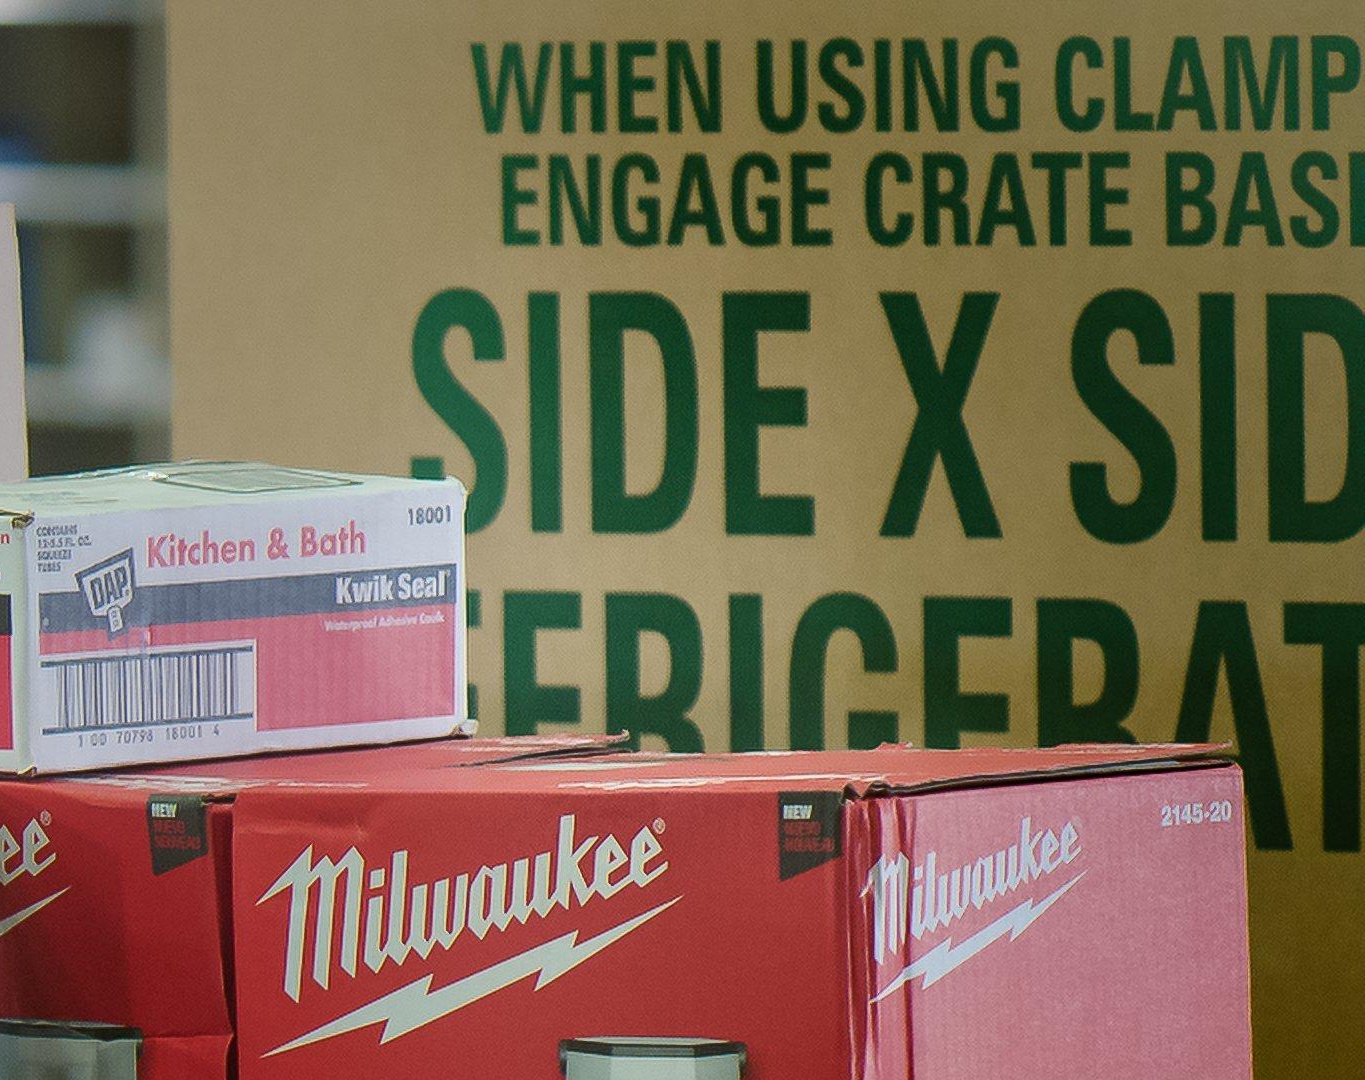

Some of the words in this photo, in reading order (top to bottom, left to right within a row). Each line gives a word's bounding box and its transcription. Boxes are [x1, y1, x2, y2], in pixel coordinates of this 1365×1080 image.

[470, 40, 722, 134] WHEN
[757, 39, 1020, 133] USING
[1054, 35, 1362, 132] CLAMP
[502, 152, 833, 247] ENGAGE
[867, 152, 1132, 247] CRATE
[410, 287, 815, 536] SIDE
[877, 291, 1002, 540] X
[146, 531, 256, 568] Kitchen
[267, 528, 290, 560] &
[300, 520, 367, 558] Bath
[407, 505, 452, 526] 18001
[88, 567, 128, 611] DAP
[335, 574, 395, 605] Kwik
[396, 570, 450, 601] Seal
[1160, 800, 1233, 827] 2145-20
[255, 813, 671, 1004] Milwaukee
[859, 816, 1083, 966] Milwaukee
